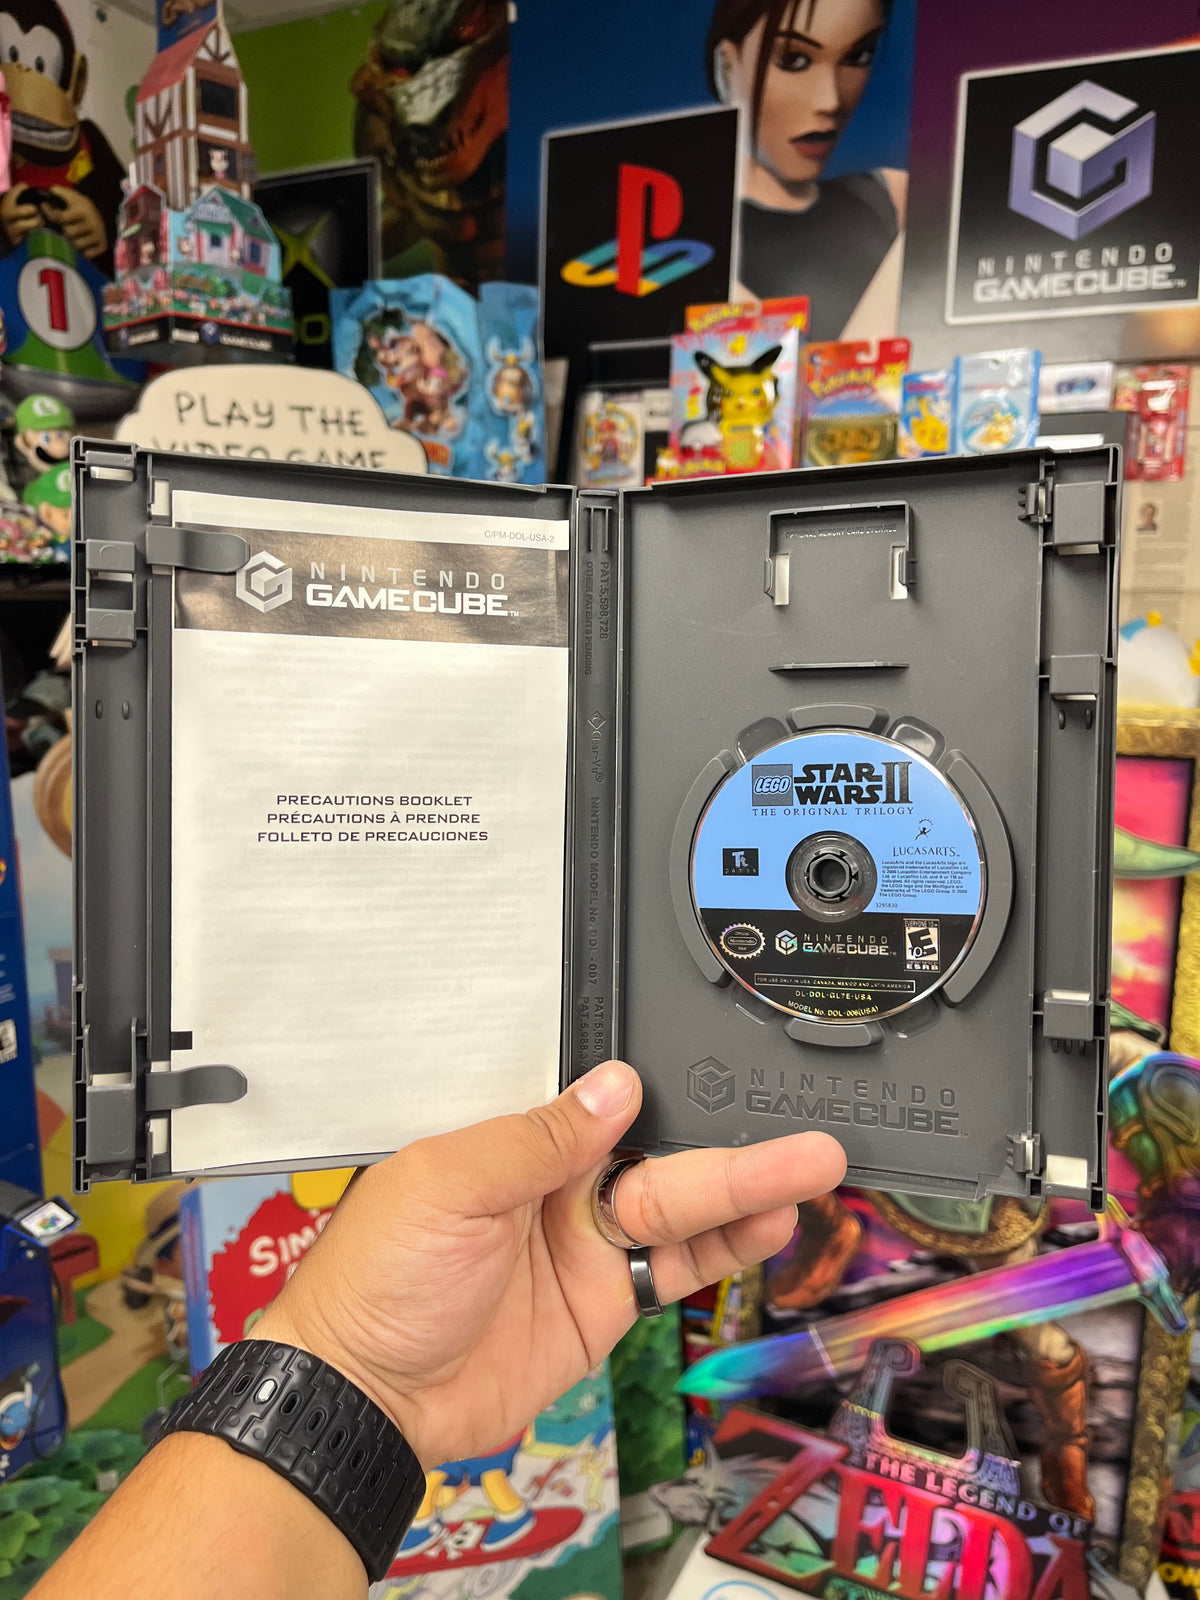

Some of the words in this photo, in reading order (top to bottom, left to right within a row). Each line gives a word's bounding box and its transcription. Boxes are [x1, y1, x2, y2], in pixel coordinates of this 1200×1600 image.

[977, 241, 1173, 277] NINTENDO
[174, 391, 275, 429] PLAY
[289, 405, 369, 437] THE
[484, 530, 555, 543] C/PM-DOL-USA-2
[310, 561, 505, 590] NINTENDO
[794, 763, 882, 783] STAR
[881, 761, 913, 804] II
[754, 776, 792, 794] LEGO
[795, 785, 883, 805] WARS
[276, 795, 395, 806] PRECAUTIONS
[399, 796, 473, 807] BOOKLET
[783, 808, 848, 816] ORIGINAL
[855, 806, 915, 816] TRILOGY
[267, 811, 386, 824] PRÉCAUTIONS
[390, 811, 401, 824] À
[405, 813, 481, 824] PRENDRE
[257, 832, 333, 843] FOLLETO
[338, 832, 360, 843] DE
[365, 831, 488, 842] PRECAUCIONES
[804, 933, 889, 945] NINTENDO
[907, 928, 937, 959] E
[787, 1000, 813, 1014] MODEL
[750, 1068, 956, 1109] NINTENDO
[704, 1408, 1091, 1600] ZELDA
[865, 1453, 915, 1483] THE
[925, 1469, 1038, 1521] LEGEND
[1048, 1511, 1089, 1538] OF
